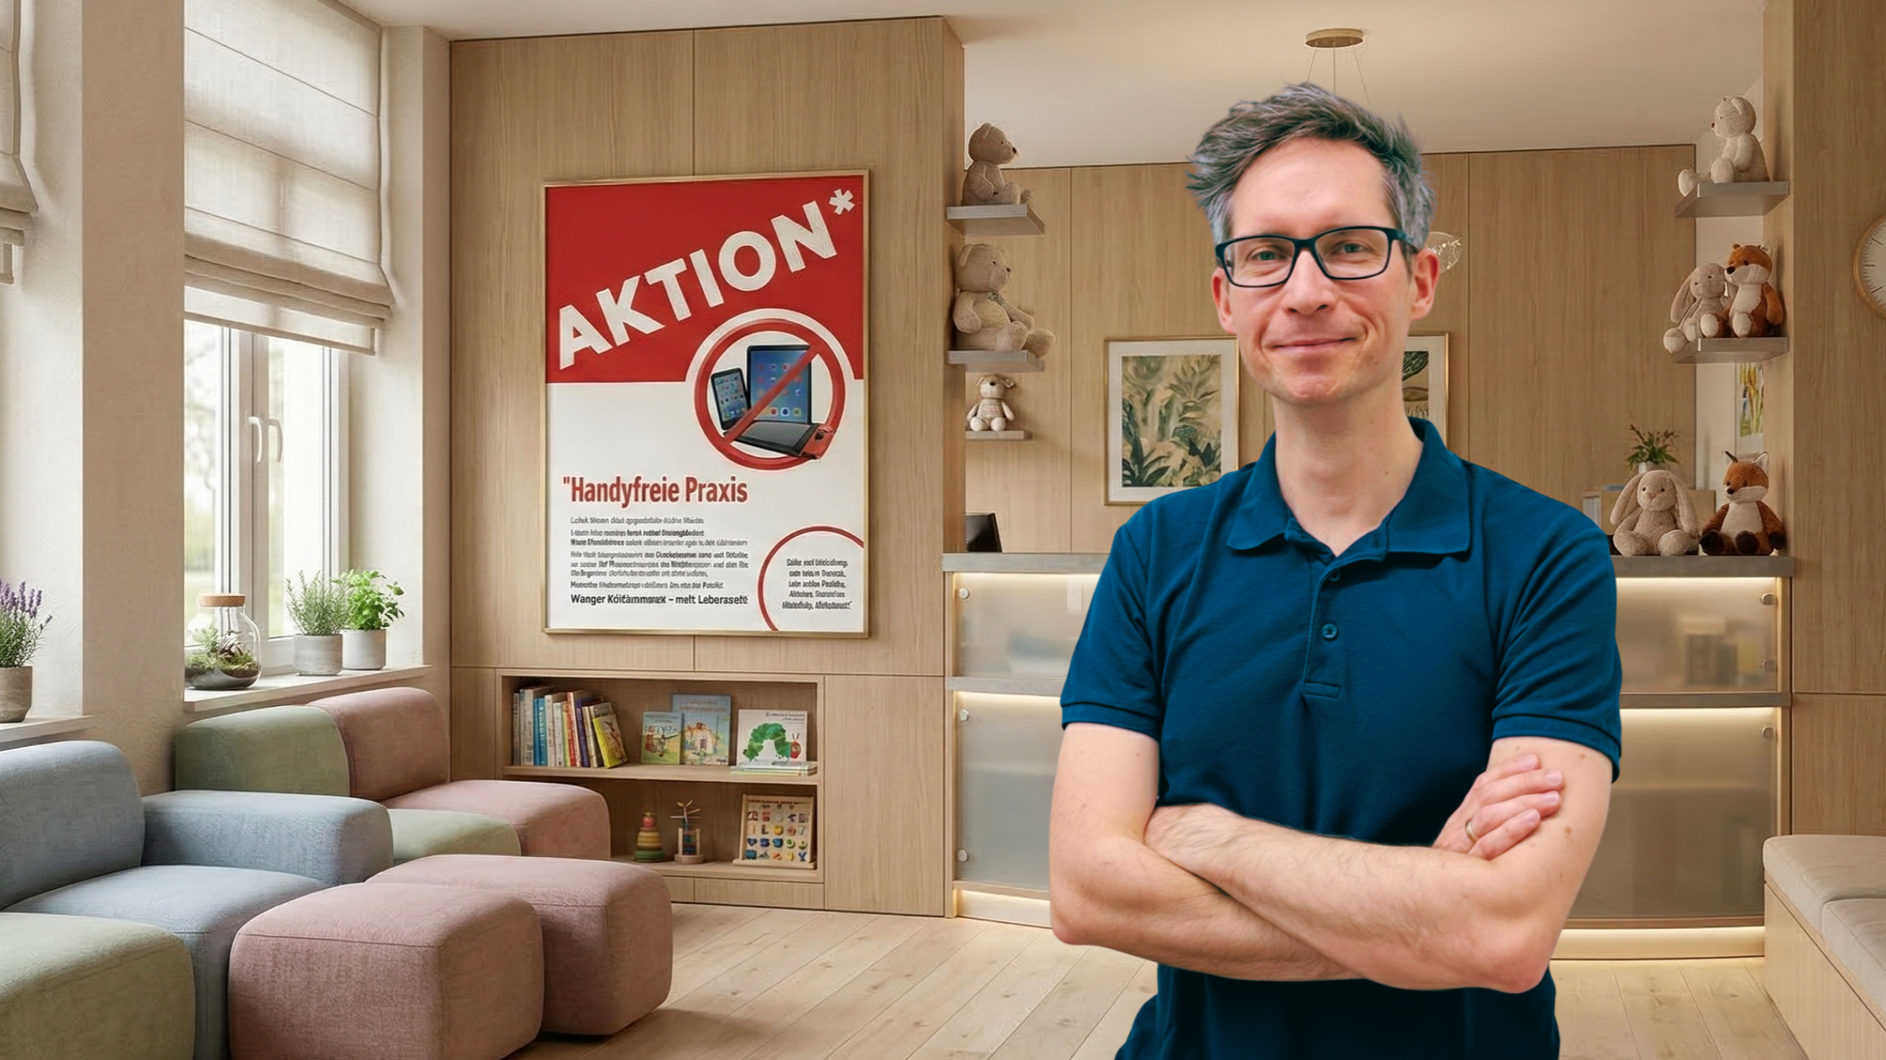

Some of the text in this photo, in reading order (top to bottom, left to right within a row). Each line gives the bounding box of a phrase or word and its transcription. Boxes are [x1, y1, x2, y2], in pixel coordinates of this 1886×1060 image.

[563, 476, 748, 508] "Handyfreie Praxis
[570, 594, 606, 606] Wanger
